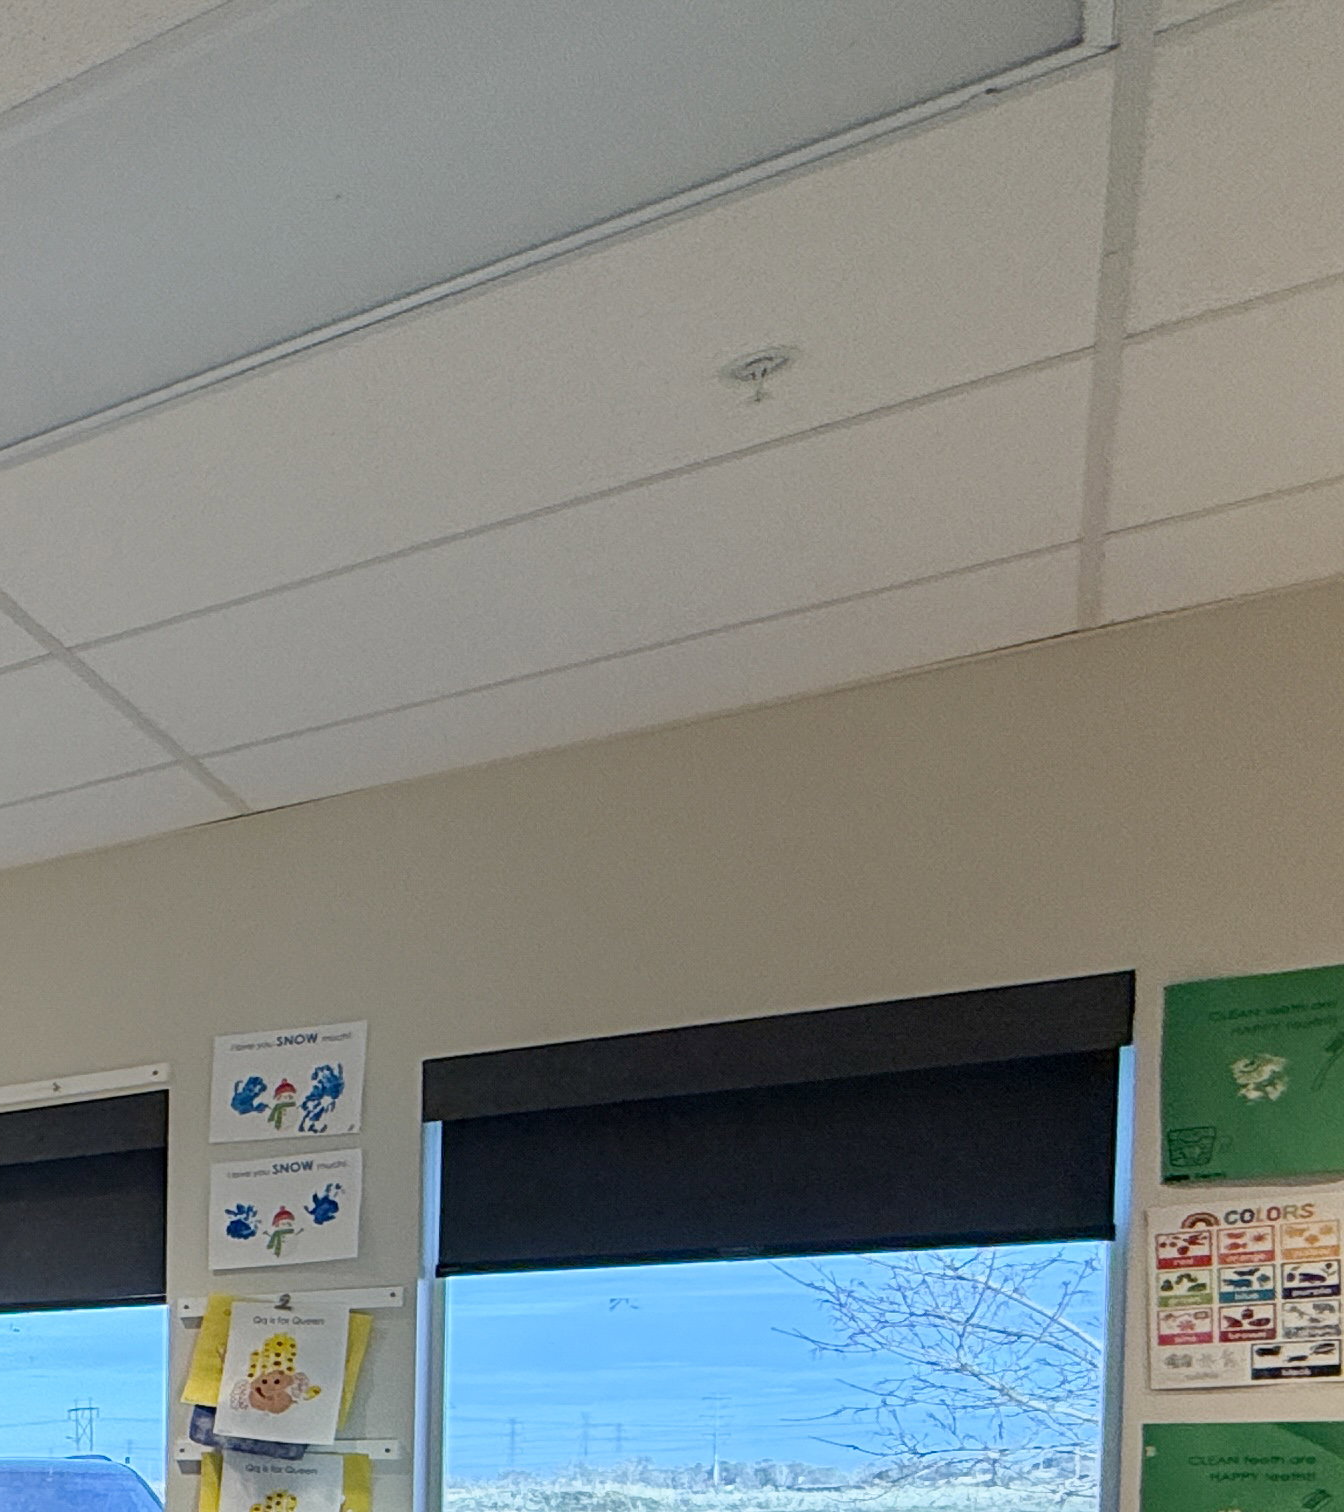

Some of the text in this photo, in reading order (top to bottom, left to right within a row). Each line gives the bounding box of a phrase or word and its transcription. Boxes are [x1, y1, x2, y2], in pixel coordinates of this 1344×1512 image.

[276, 1033, 318, 1047] SNOW
[272, 1161, 313, 1175] SNOW
[1224, 1203, 1315, 1225] COLORS
[1234, 1292, 1260, 1300] blue
[253, 1316, 325, 1326] Qq is for Queen
[1189, 1456, 1316, 1465] CLEAN teeth are
[285, 1466, 318, 1475] Queen
[1210, 1473, 1259, 1482] HAPPY
